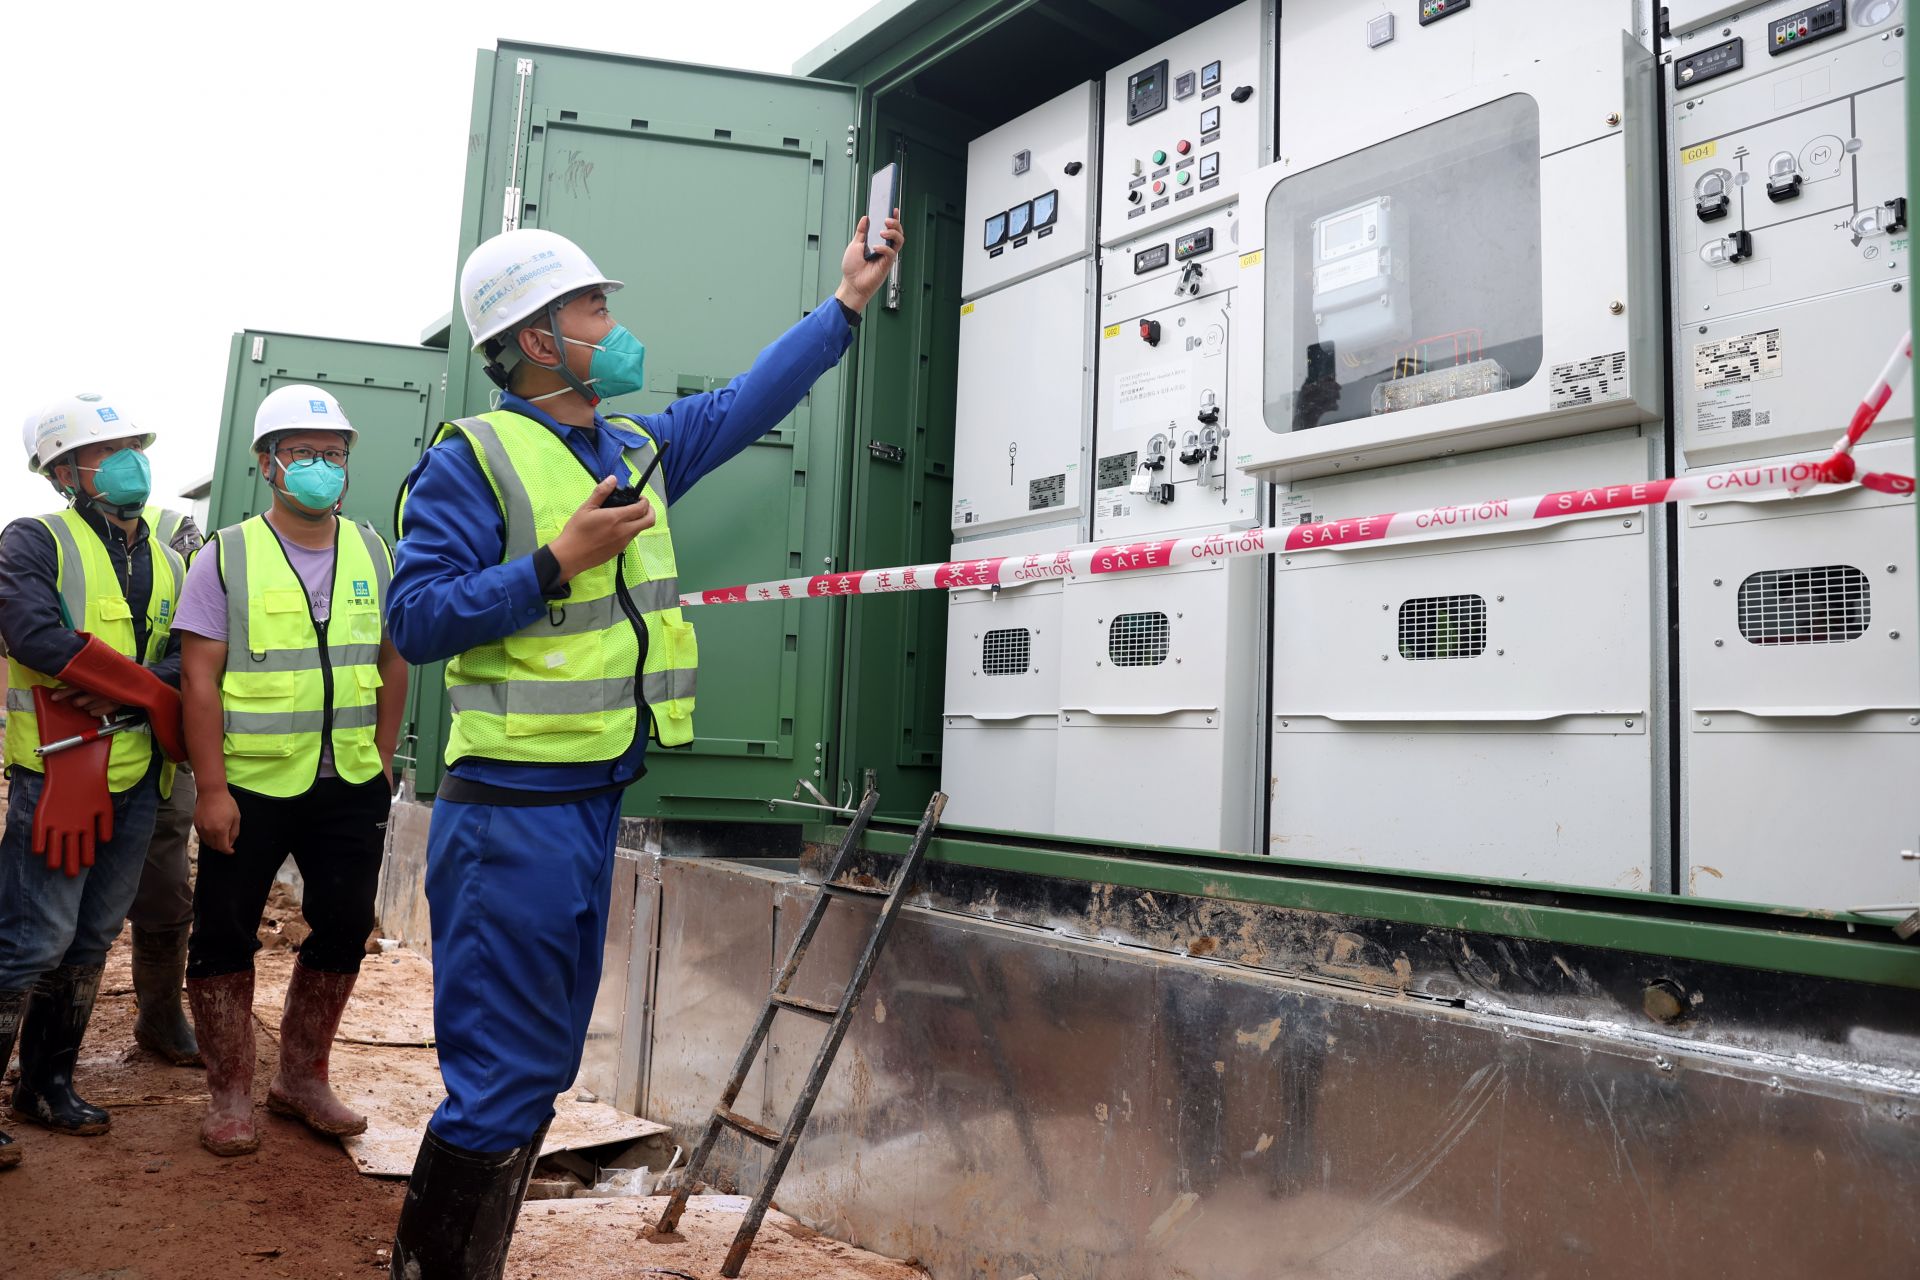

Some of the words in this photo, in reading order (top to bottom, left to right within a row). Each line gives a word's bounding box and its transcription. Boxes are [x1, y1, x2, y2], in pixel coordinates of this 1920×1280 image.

[1688, 146, 1709, 160] G04
[1243, 254, 1258, 265] G03
[1014, 563, 1074, 580] CAUTION
[1102, 550, 1158, 571] SAFE
[1191, 537, 1265, 558] CAUTION
[1302, 521, 1371, 544] SAFE
[1416, 503, 1509, 529] CAUTION
[1558, 484, 1647, 509] SAFE
[816, 576, 853, 596] 安全
[876, 568, 918, 588] 注意
[948, 559, 992, 579] 安全
